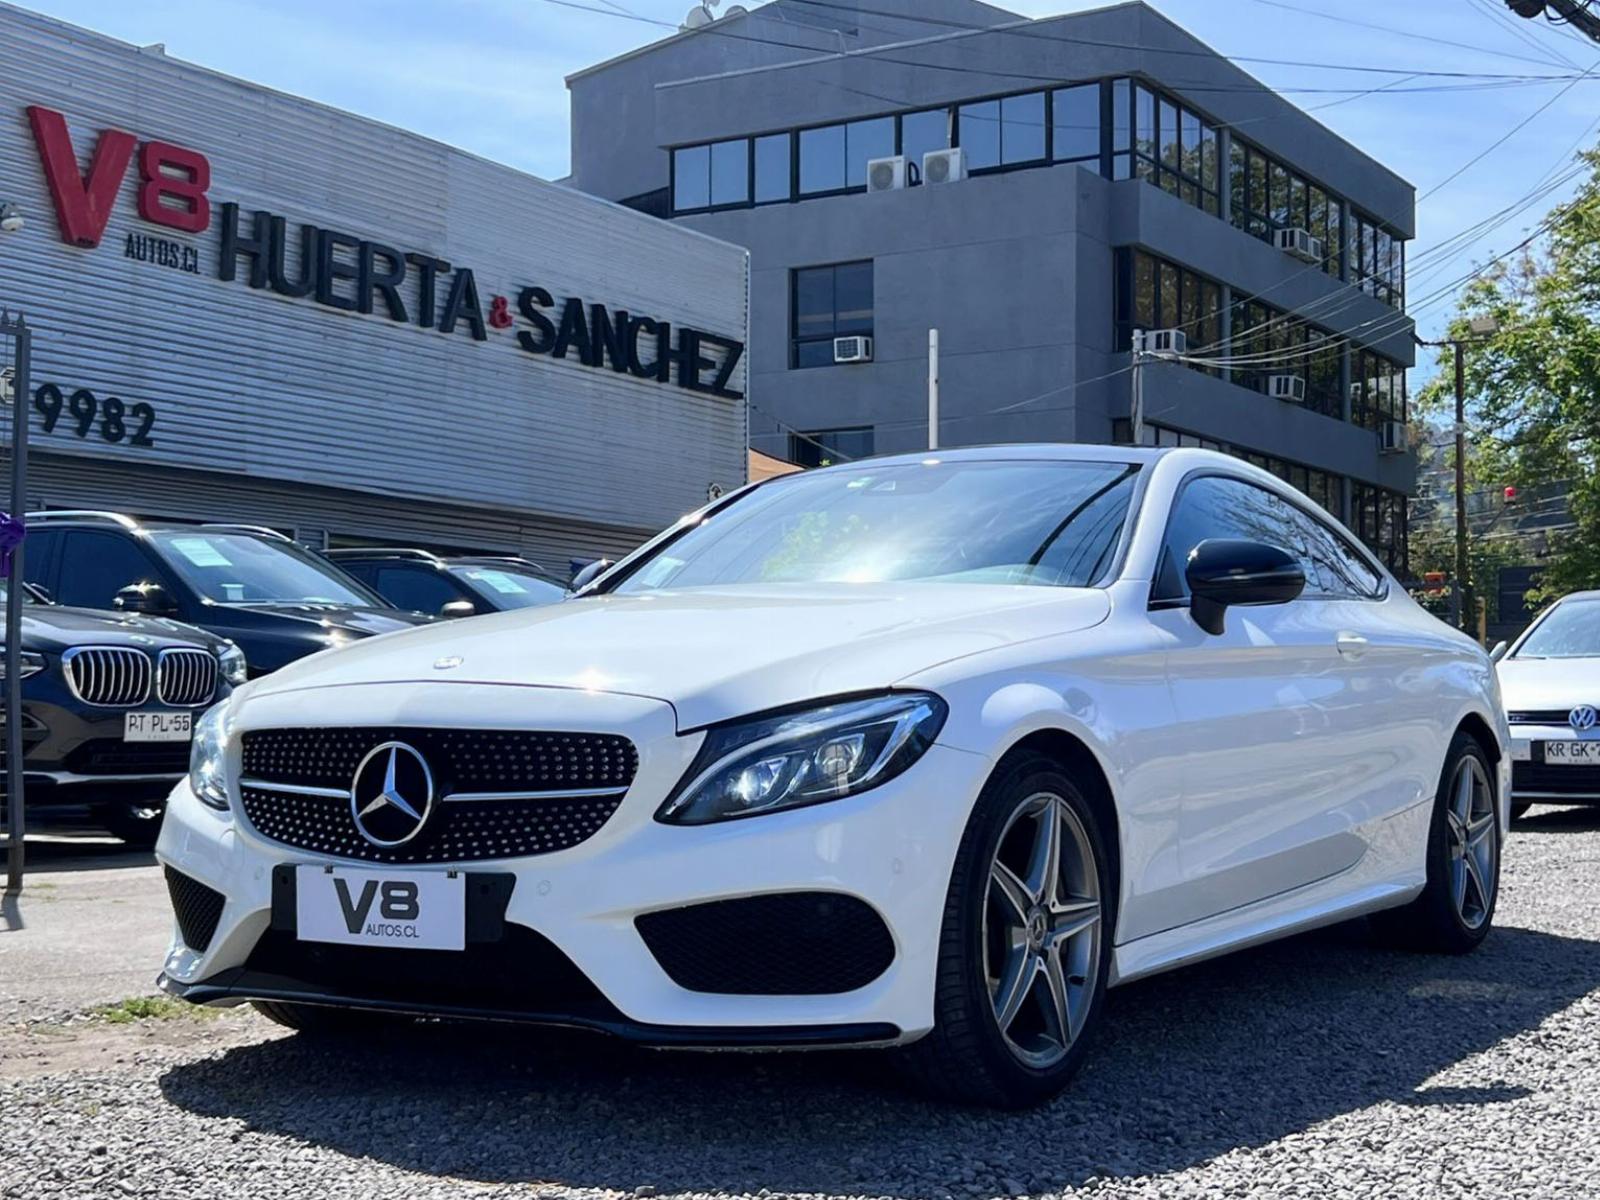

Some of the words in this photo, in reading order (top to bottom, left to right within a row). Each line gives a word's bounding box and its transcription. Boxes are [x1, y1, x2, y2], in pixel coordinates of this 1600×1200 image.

[26, 104, 211, 249] V8
[124, 232, 200, 274] AUTOS.CL
[219, 201, 487, 341] HUERTA
[488, 295, 513, 329] &
[516, 286, 744, 400] SANCHEZ
[34, 382, 155, 447] 9982
[1546, 742, 1565, 757] KR
[333, 877, 420, 934] V8
[365, 923, 420, 938] AUTOS.CL
